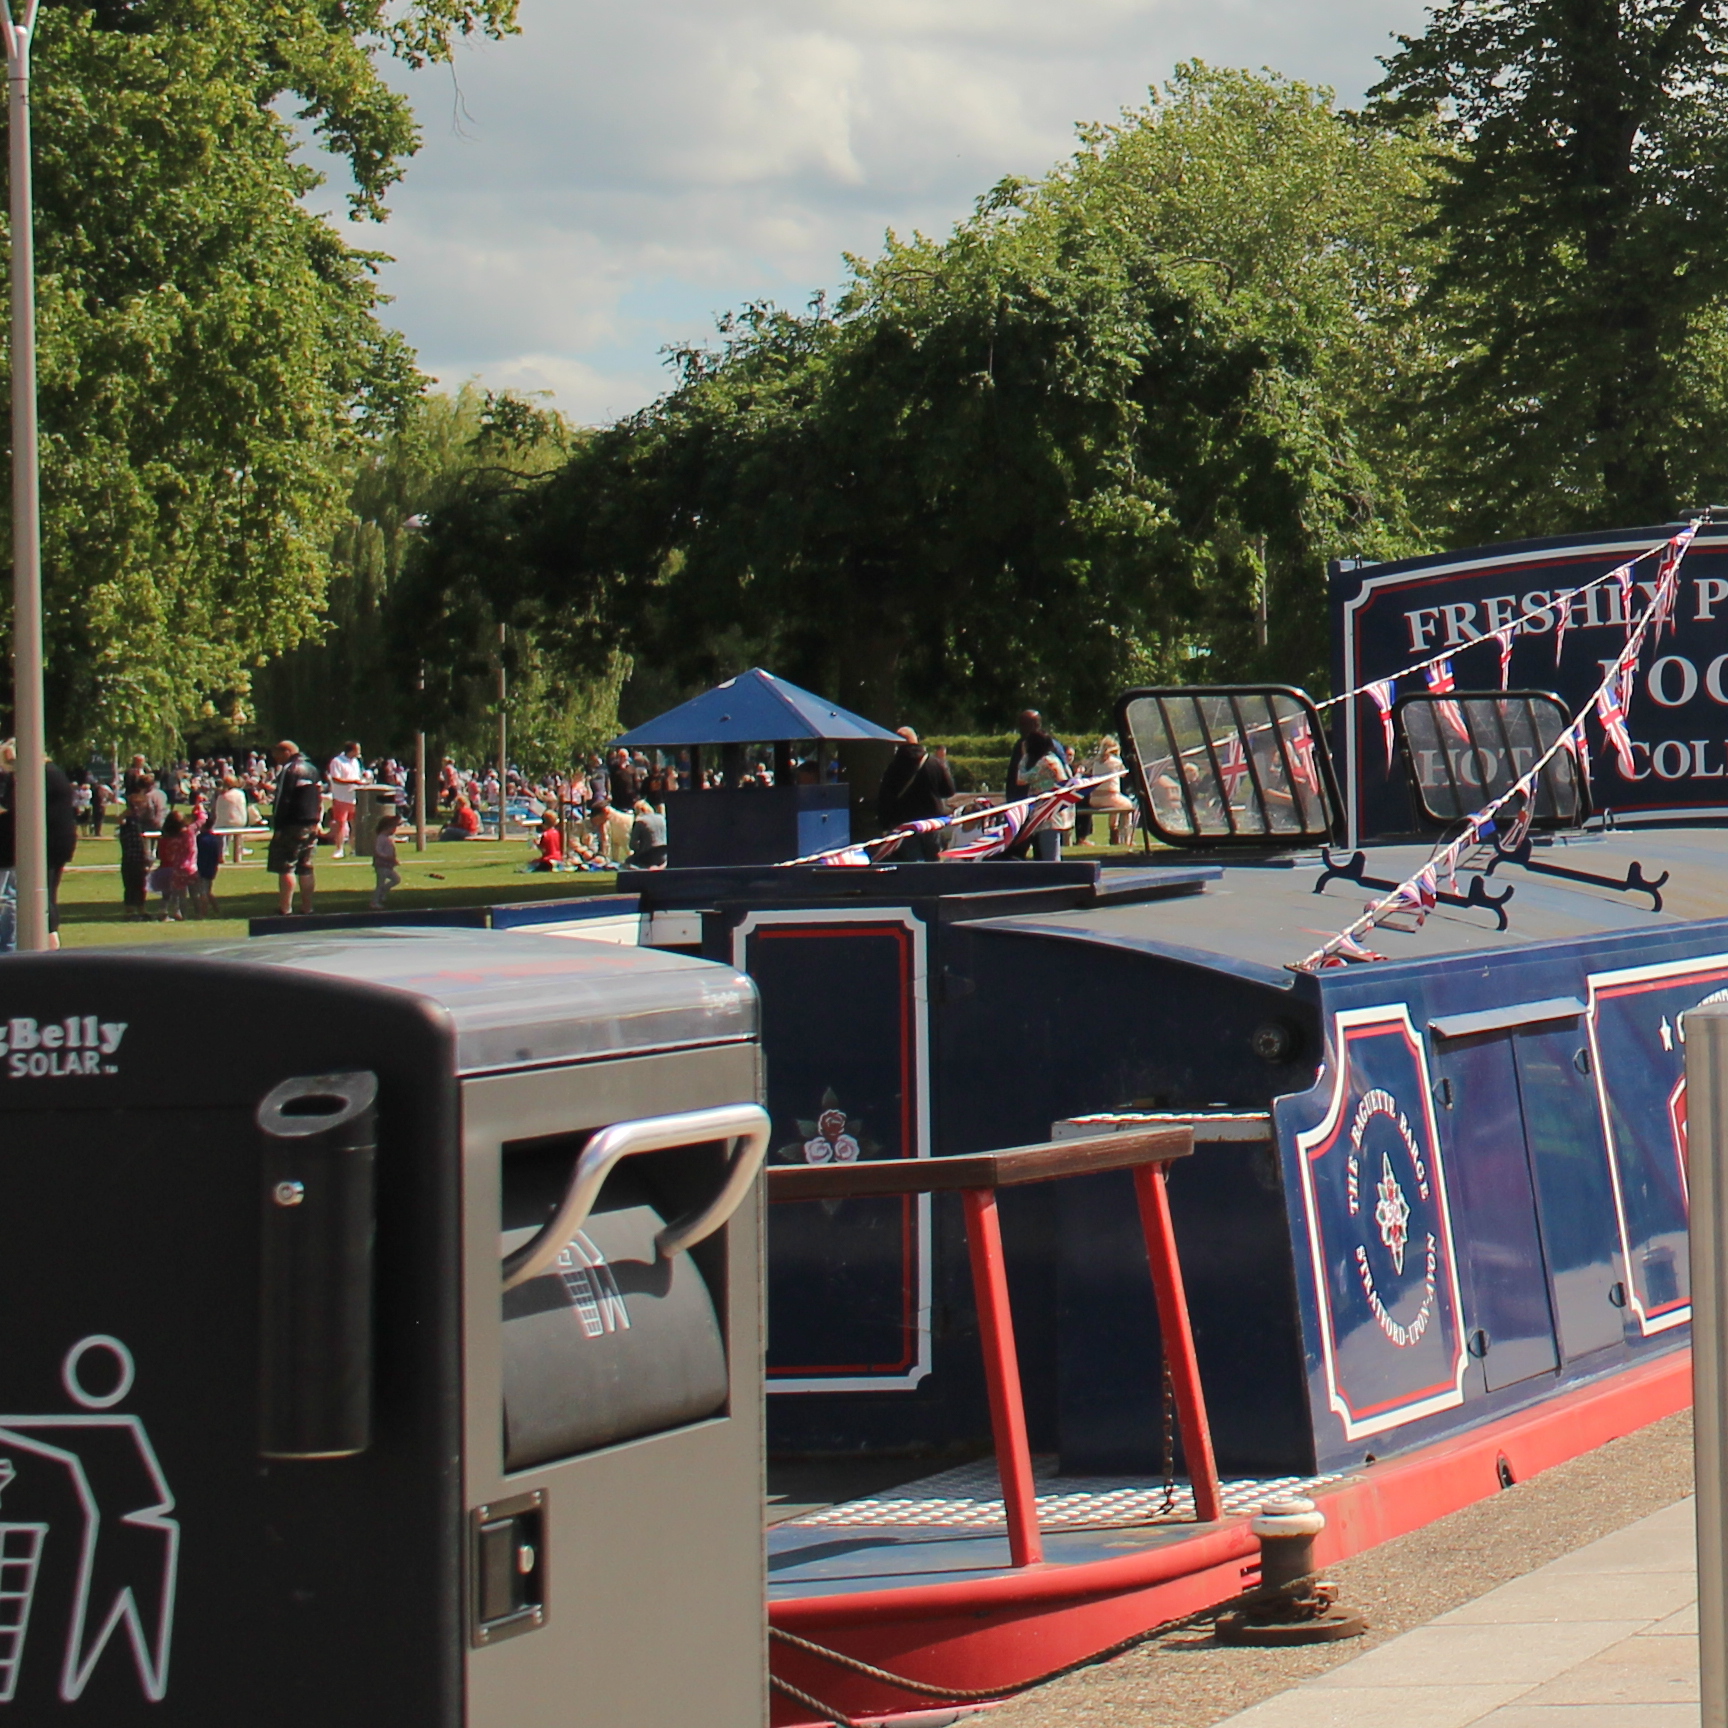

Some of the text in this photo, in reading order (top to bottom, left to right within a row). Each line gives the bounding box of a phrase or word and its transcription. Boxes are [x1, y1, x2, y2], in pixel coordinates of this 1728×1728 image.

[1404, 582, 1674, 654] FRESHLY
[1418, 746, 1533, 789] HOT
[8, 1050, 101, 1078] SOLAR
[1350, 1087, 1397, 1150] BAGUETTE
[1398, 1110, 1431, 1202] BARGE
